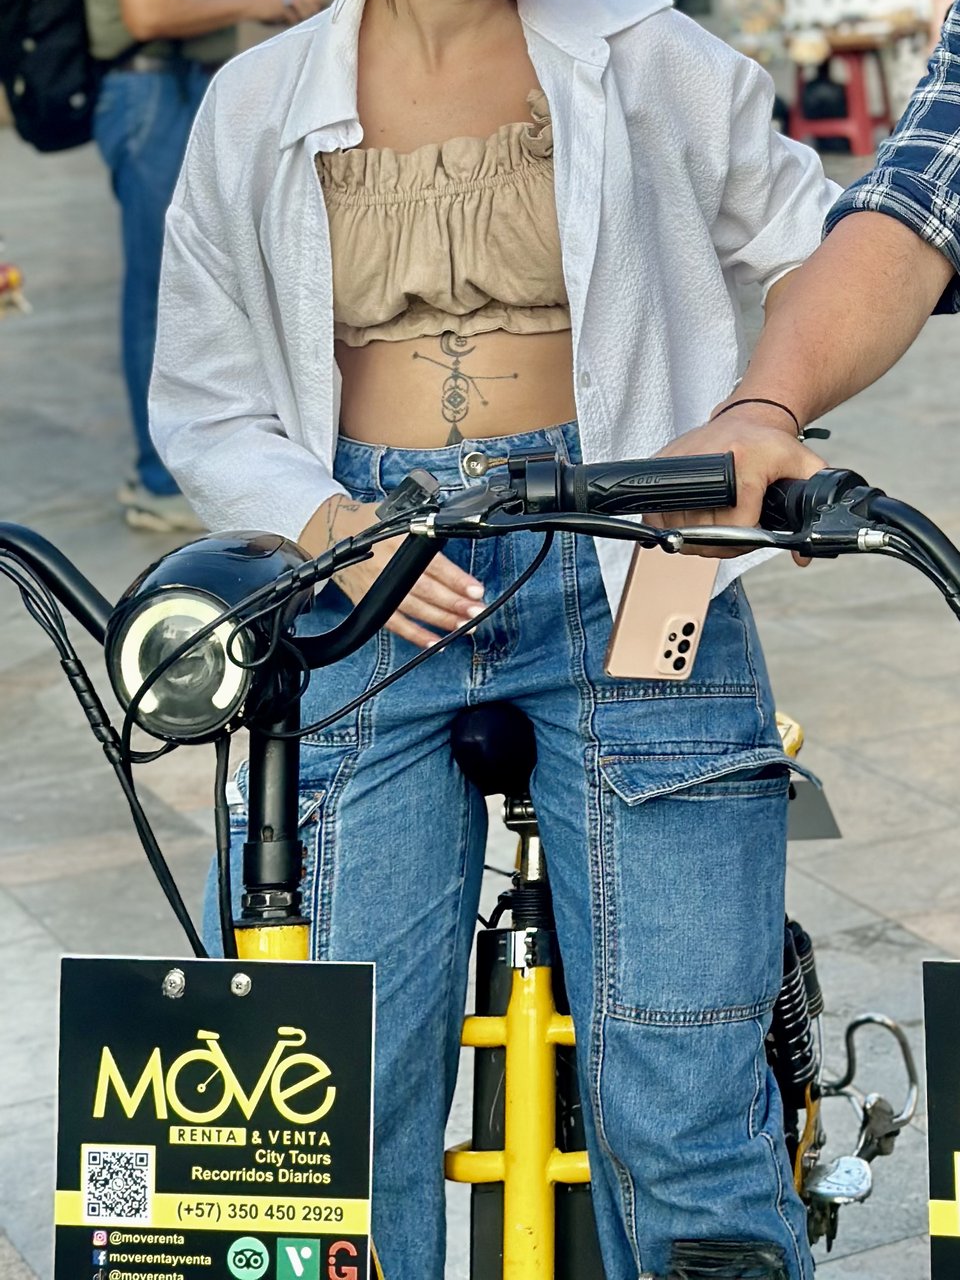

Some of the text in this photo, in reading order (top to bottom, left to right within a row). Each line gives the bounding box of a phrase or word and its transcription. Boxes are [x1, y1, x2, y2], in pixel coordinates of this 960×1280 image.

[177, 1128, 331, 1146] RENTA & VENTA
[255, 1149, 331, 1167] City Tours
[191, 1166, 331, 1184] Recorridos Diarios
[177, 1202, 344, 1222] (+57) 350 450 2929
[109, 1231, 185, 1245] @moverenta
[109, 1253, 212, 1266] moverentayventa
